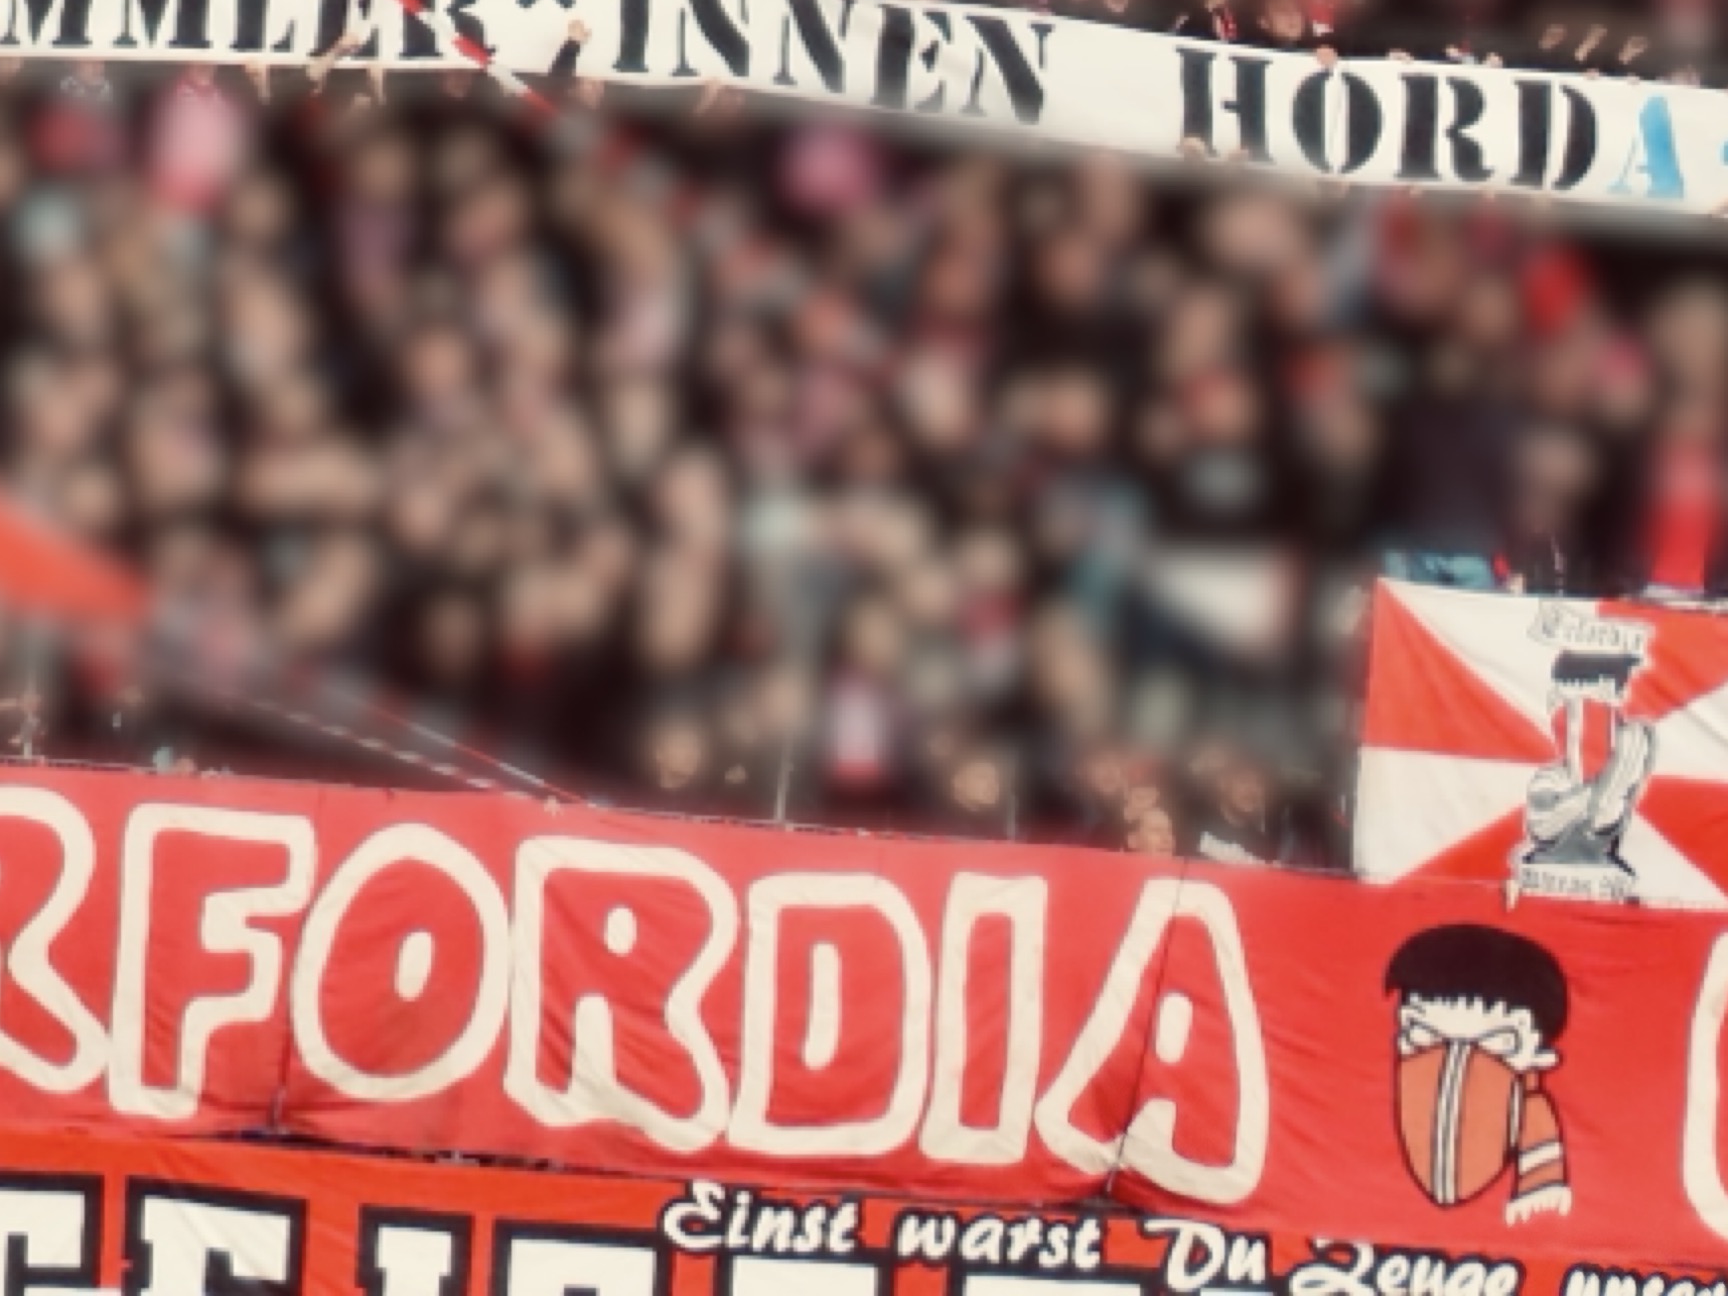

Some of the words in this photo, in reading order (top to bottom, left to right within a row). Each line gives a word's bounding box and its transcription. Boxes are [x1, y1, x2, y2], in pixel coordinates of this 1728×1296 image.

[663, 1179, 859, 1250] Einst
[896, 1208, 1103, 1267] warst
[1142, 1217, 1268, 1293] Du
